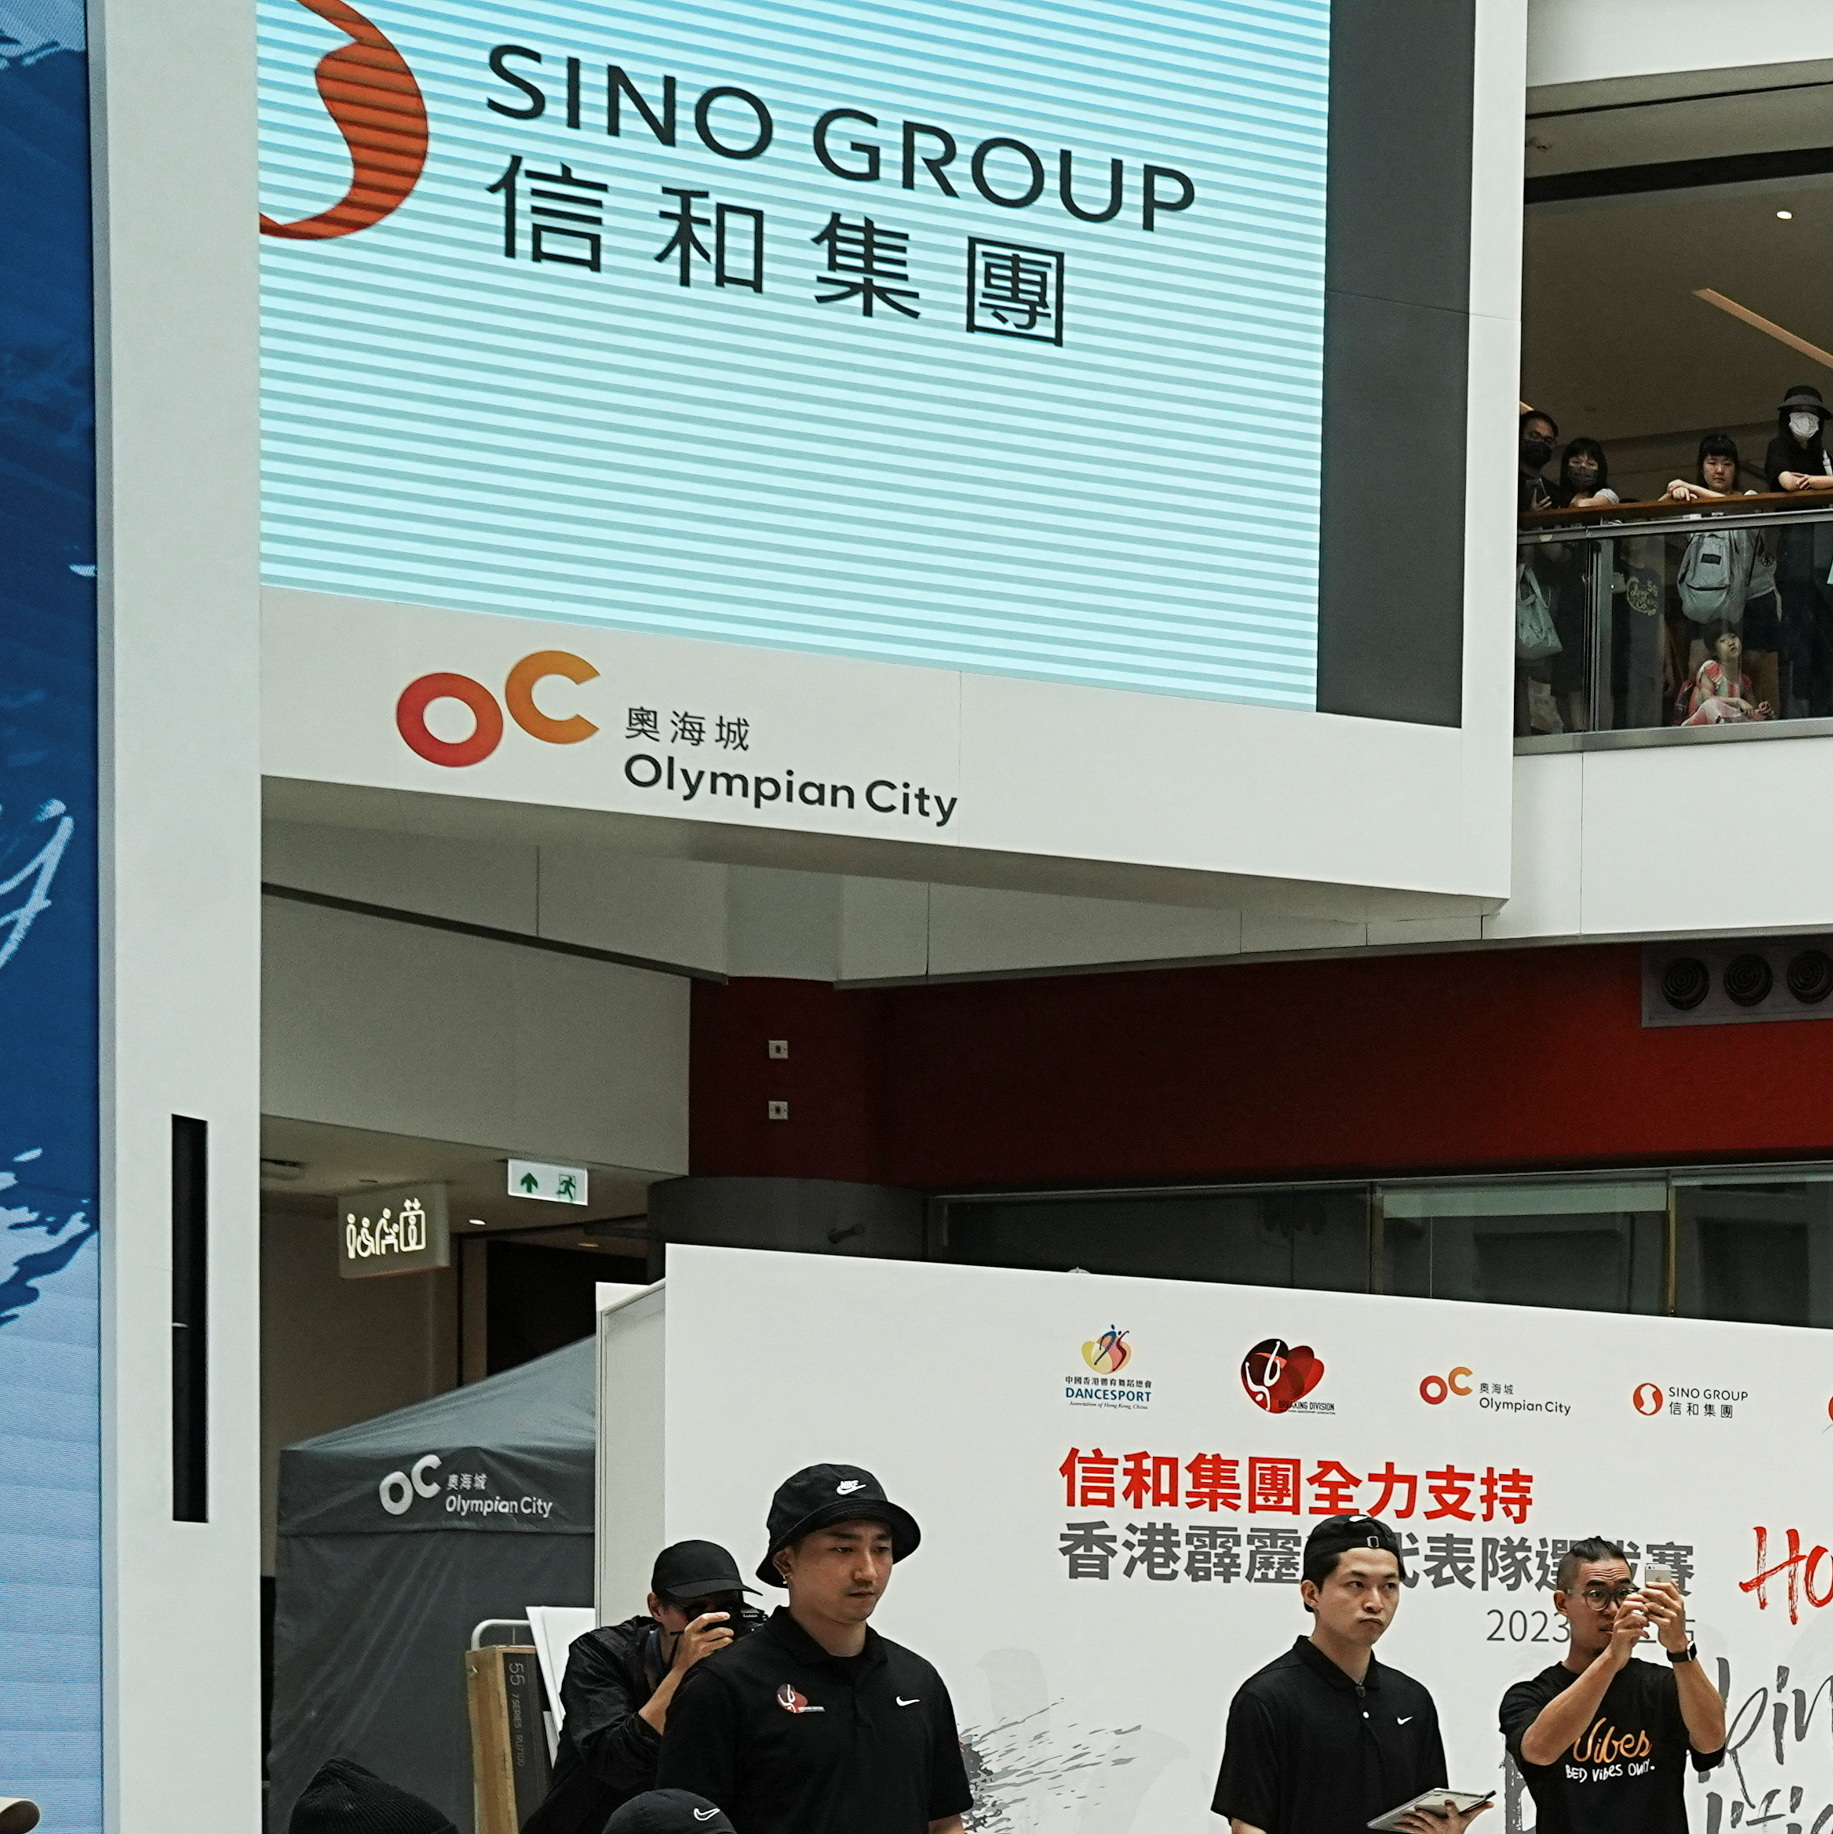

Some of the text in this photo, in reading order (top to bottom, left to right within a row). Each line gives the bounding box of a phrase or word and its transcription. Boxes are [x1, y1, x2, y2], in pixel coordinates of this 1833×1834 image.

[487, 43, 1196, 232] SINO GROUP
[485, 152, 1067, 348] 信和集團
[395, 650, 600, 767] OC
[624, 705, 751, 753] 奧海城
[623, 752, 959, 826] Olympian City
[1066, 1387, 1152, 1402] DANCESPORT
[1419, 1366, 1474, 1405] OC
[1479, 1382, 1514, 1396] 奧海城
[1668, 1386, 1749, 1402] SINO GROUP
[1479, 1397, 1572, 1416] Olympian City
[1668, 1401, 1733, 1419] 信和集團
[379, 1454, 443, 1515] OC
[446, 1472, 487, 1491] 奧海城
[1058, 1447, 1534, 1525] 信和集團全力支持
[444, 1494, 553, 1519] Olympian City
[1487, 1609, 1570, 1642] 2023
[508, 1662, 525, 1686] 55
[1573, 1717, 1652, 1764] Vibes
